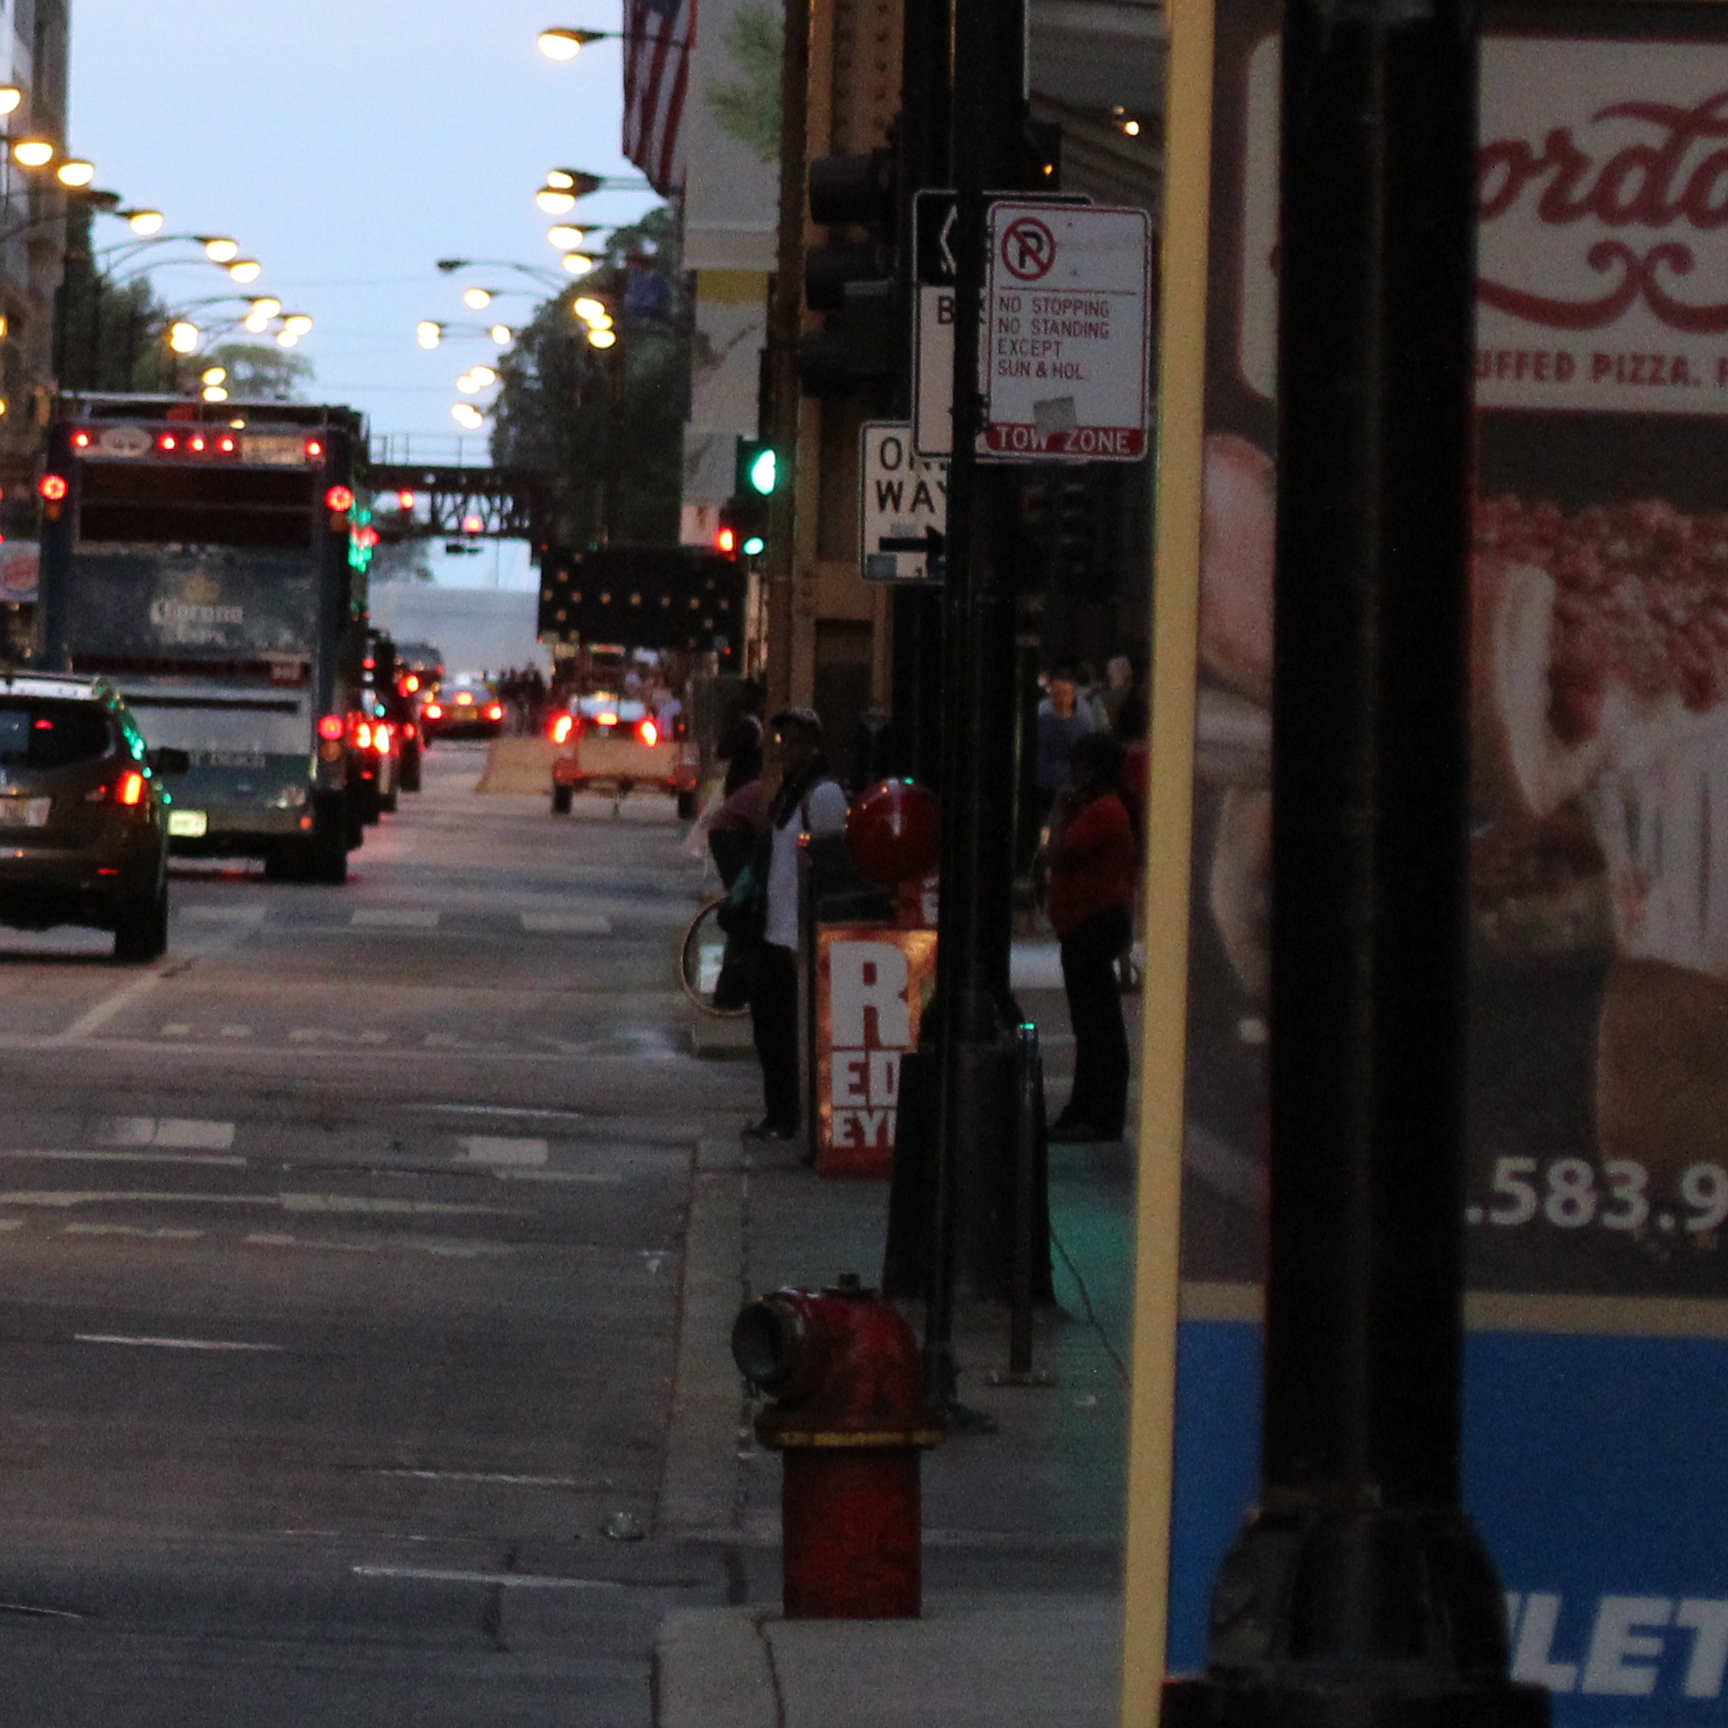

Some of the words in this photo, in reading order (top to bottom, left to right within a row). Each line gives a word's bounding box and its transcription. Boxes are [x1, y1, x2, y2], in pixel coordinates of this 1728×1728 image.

[999, 296, 1022, 314] NO
[1032, 297, 1110, 319] STOPPING
[998, 317, 1021, 335] NO
[1031, 318, 1110, 340] STANDING
[998, 338, 1062, 360] EXCEPT
[998, 360, 1031, 377] SUN
[1035, 361, 1048, 379] &
[1063, 429, 1131, 454] ZONE
[830, 941, 912, 1047] R
[1504, 1592, 1728, 1699] LET
